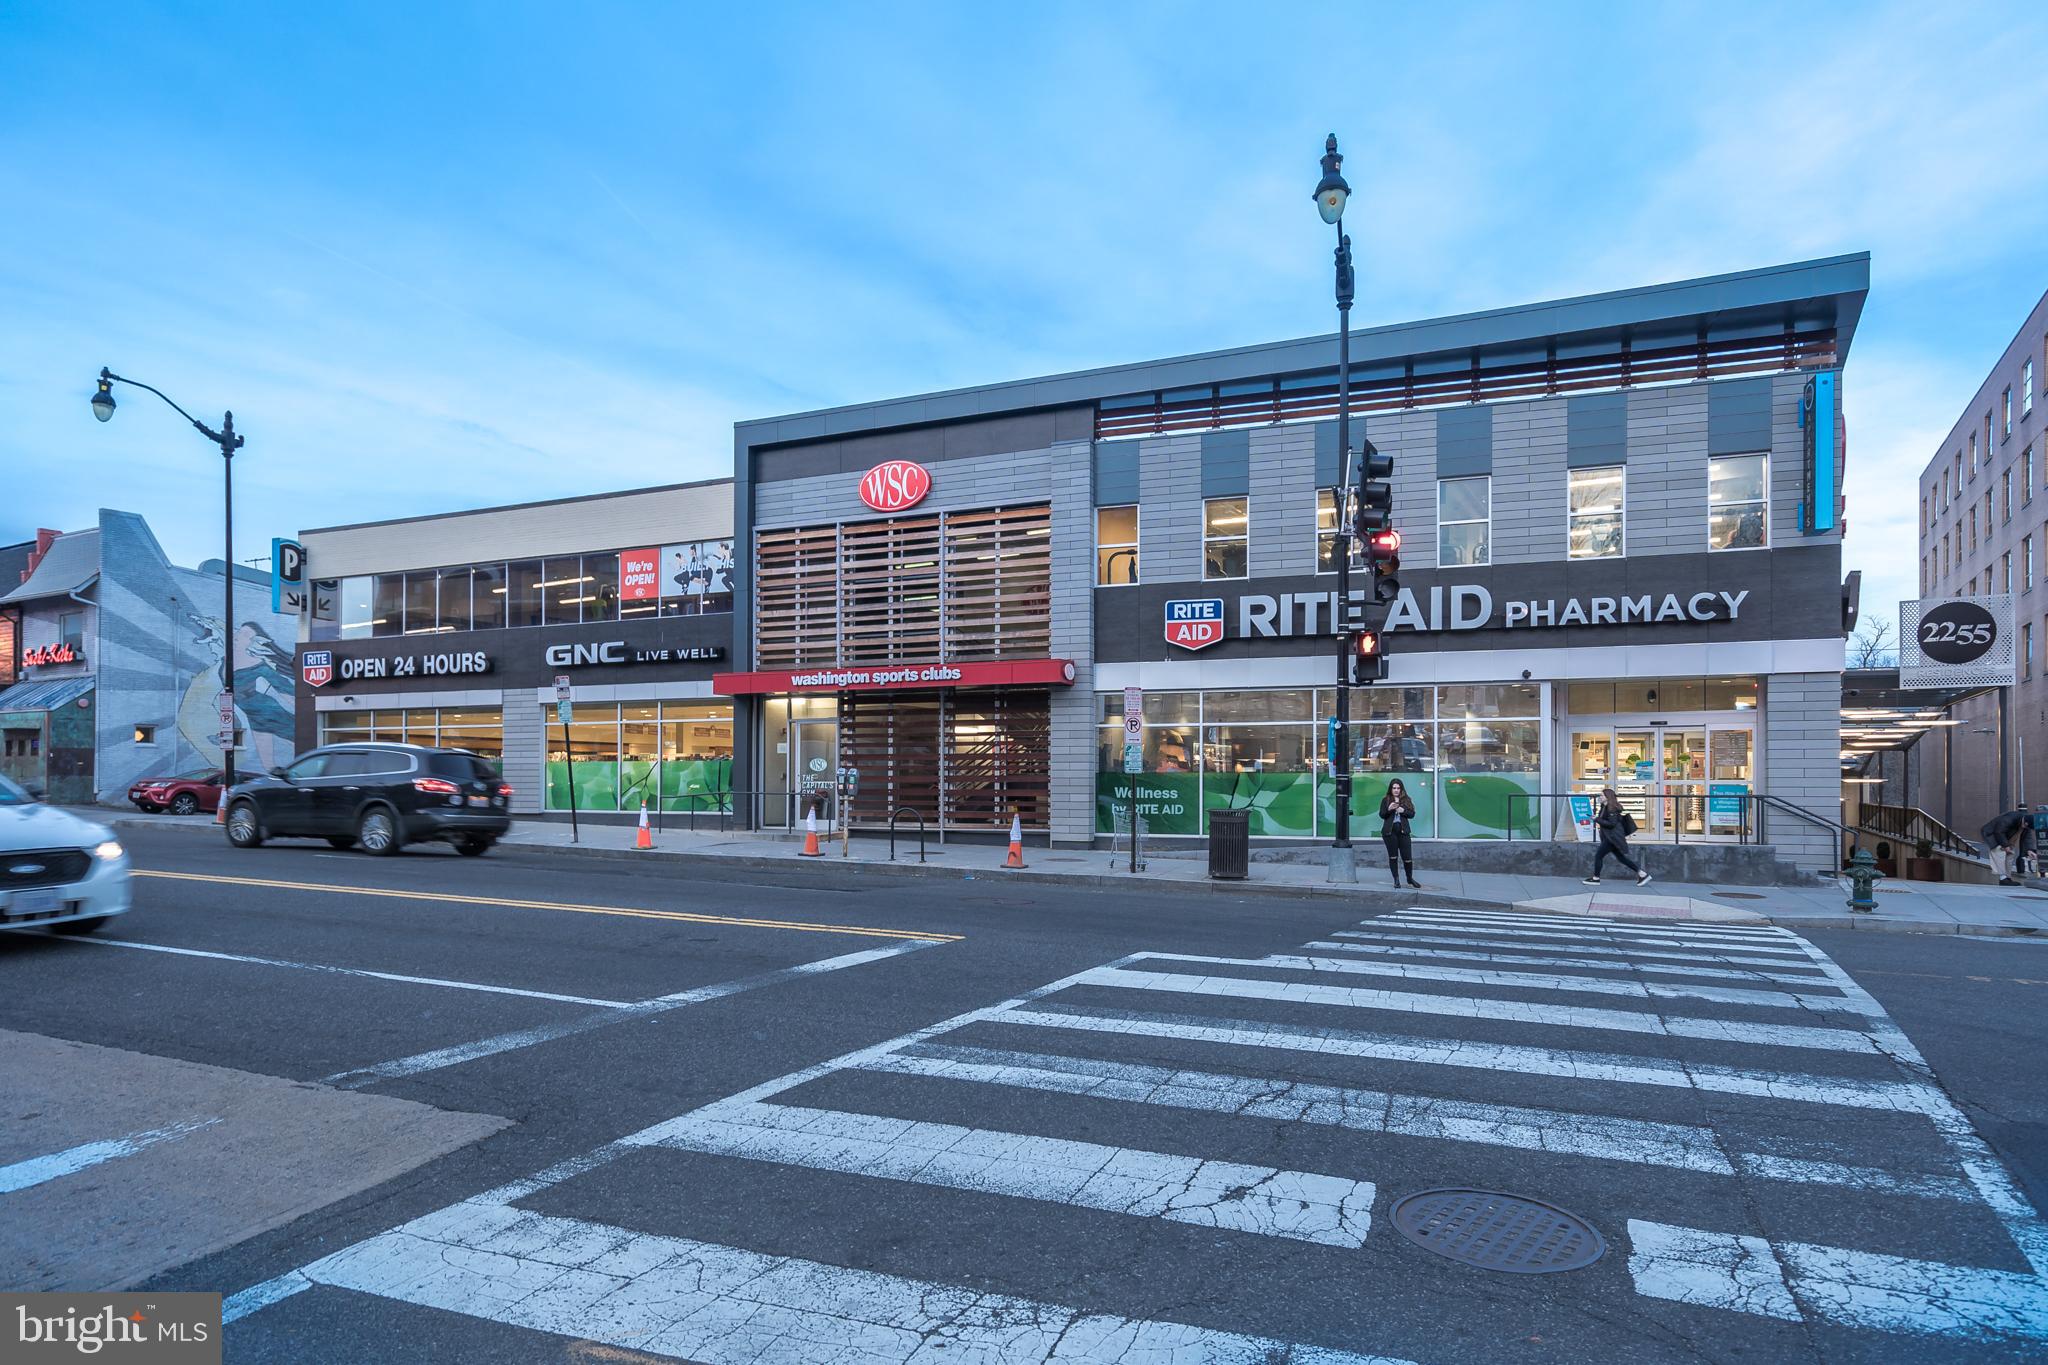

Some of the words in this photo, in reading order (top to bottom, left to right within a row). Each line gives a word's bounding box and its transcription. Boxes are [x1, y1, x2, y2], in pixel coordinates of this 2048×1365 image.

[866, 463, 918, 507] WSC
[284, 548, 299, 576] P
[626, 560, 654, 573] We're
[624, 573, 656, 586] OPEN!
[1174, 602, 1215, 619] RITE
[1239, 590, 1365, 638] RITE
[1382, 584, 1493, 632] AID
[1505, 590, 1750, 628] PHARMACY
[1176, 624, 1213, 641] AID
[1922, 621, 1991, 645] 2255
[306, 653, 328, 665] RITE
[545, 641, 625, 666] GNC
[636, 650, 669, 662] LIVE
[676, 647, 718, 660] WELL
[341, 657, 386, 679] OPEN
[394, 655, 415, 676] 24
[423, 651, 487, 675] HOURS
[308, 668, 327, 681] AID
[791, 671, 870, 687] washington
[872, 668, 919, 685] sports
[920, 666, 961, 681] clubs
[801, 781, 834, 789] CAPITAL'S
[1114, 786, 1179, 799] Wellness
[1162, 804, 1184, 815] AID
